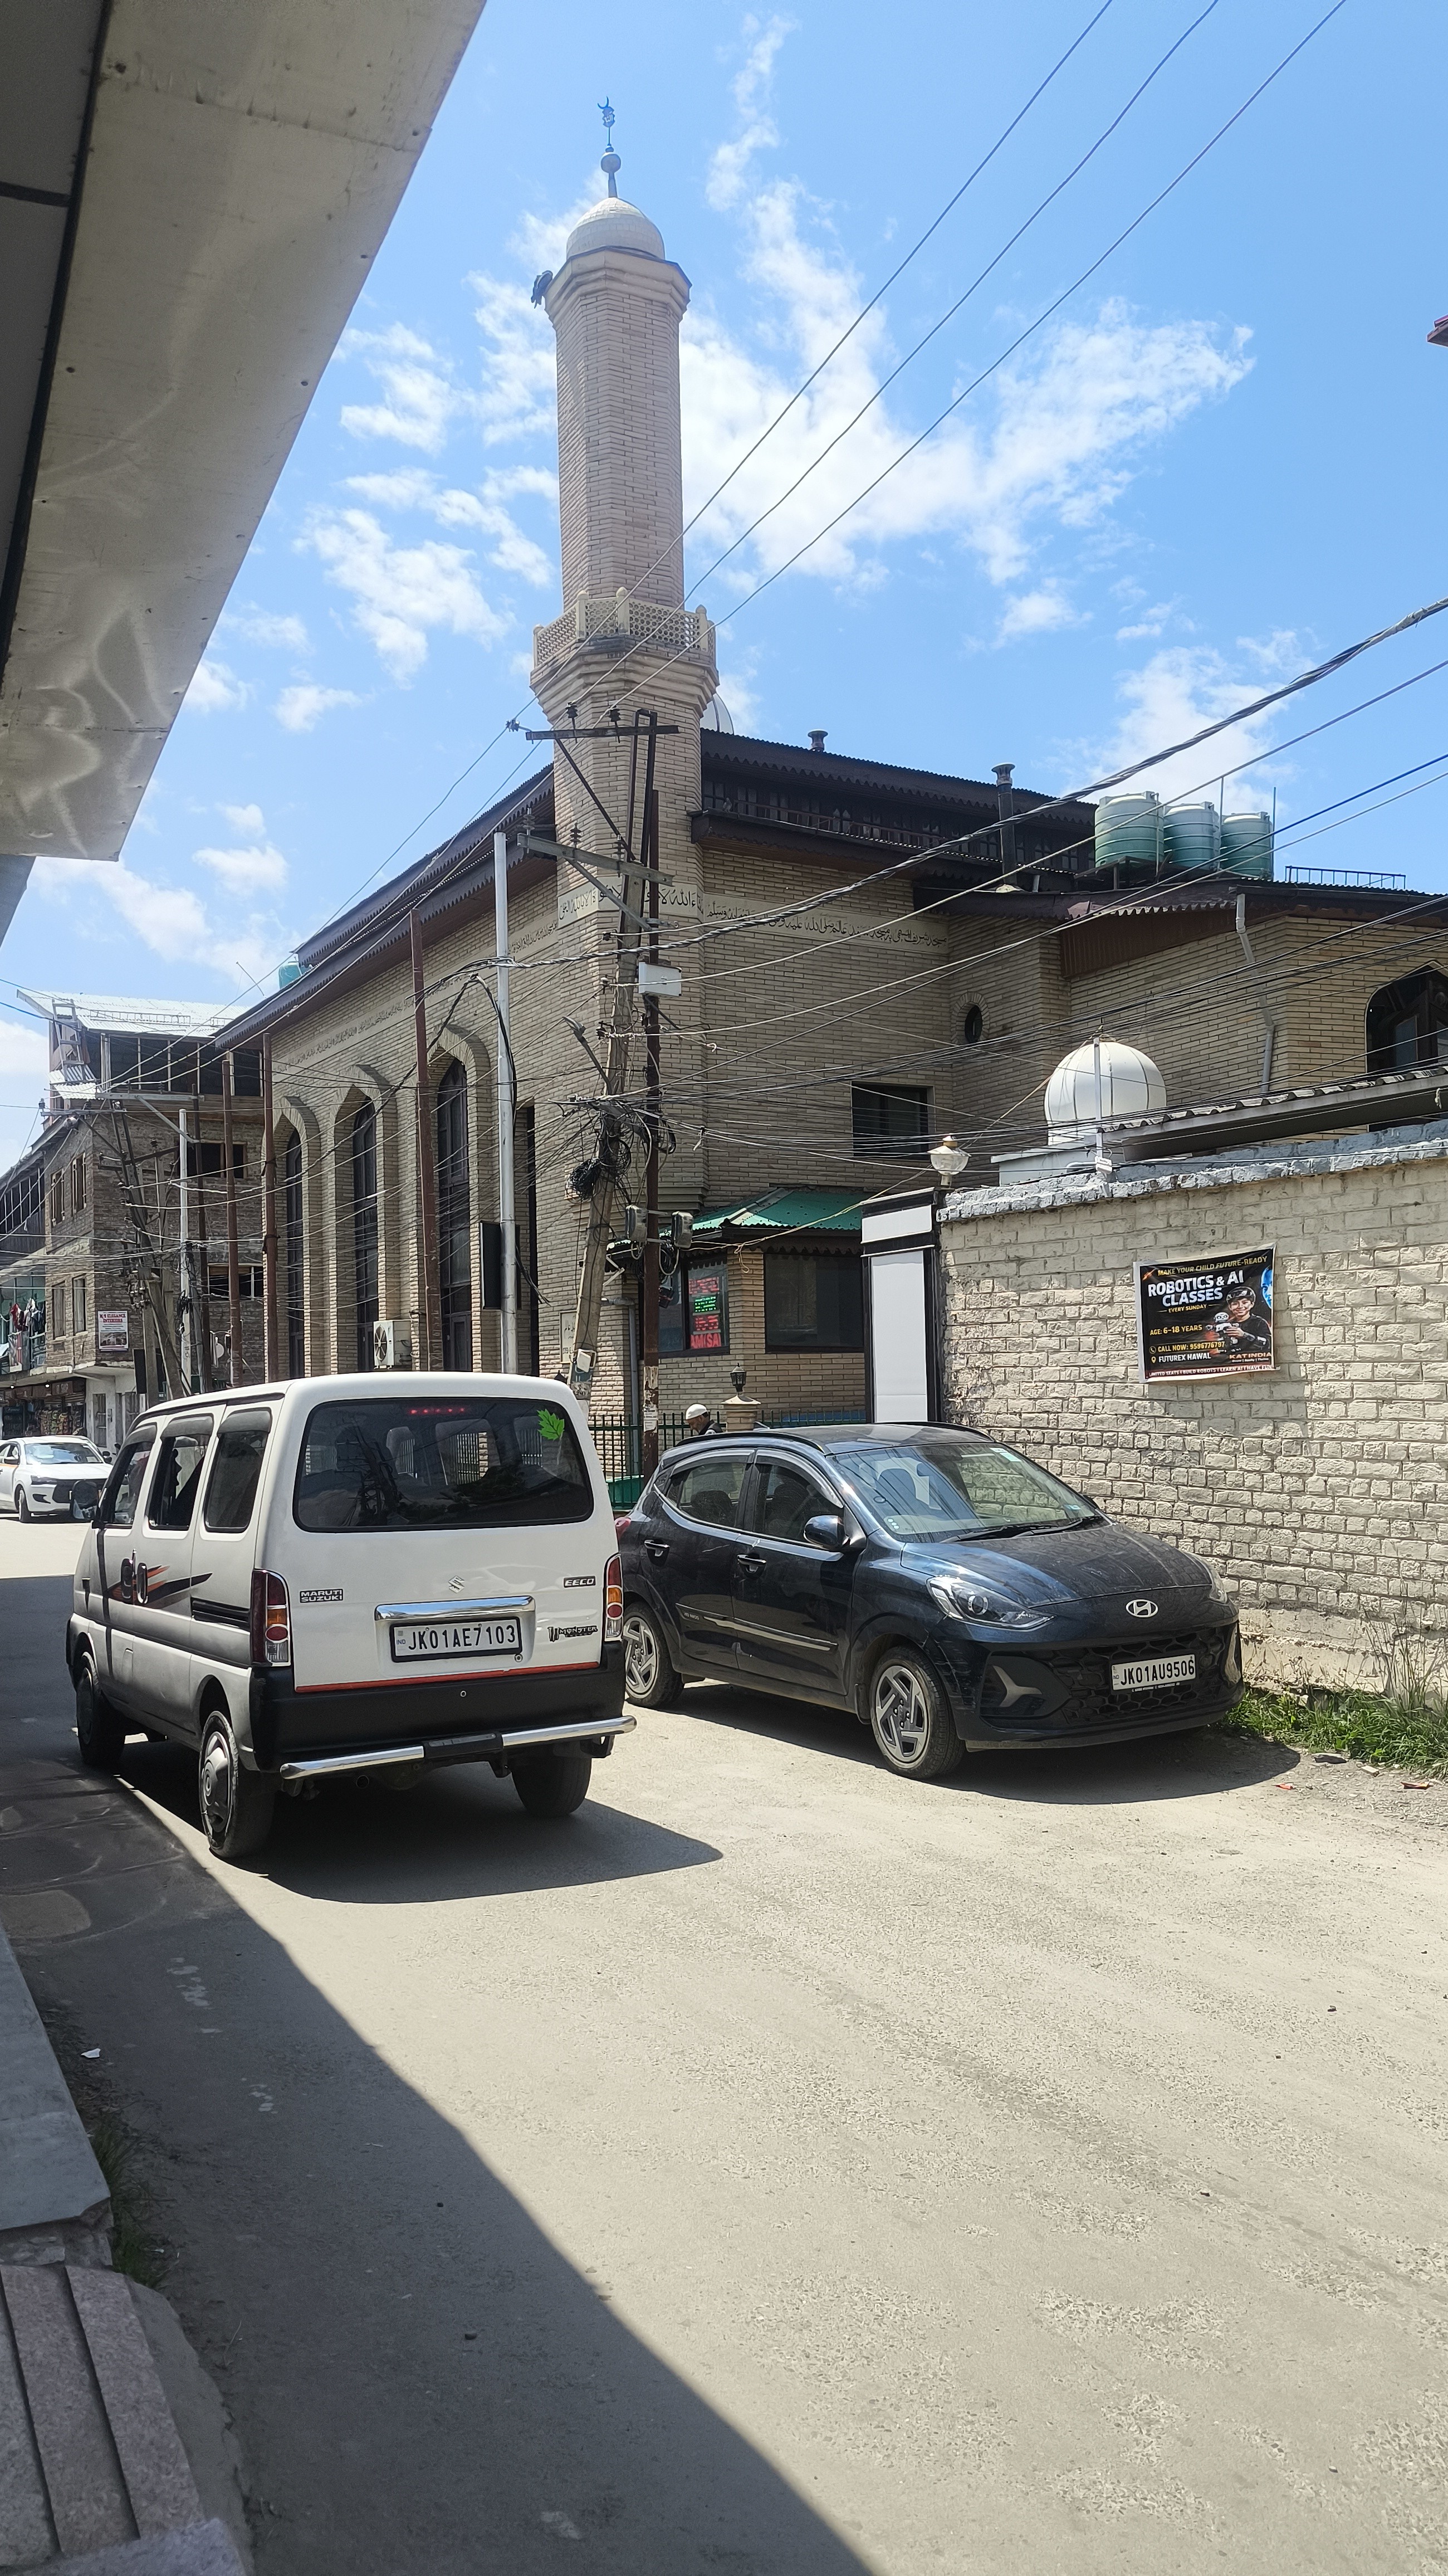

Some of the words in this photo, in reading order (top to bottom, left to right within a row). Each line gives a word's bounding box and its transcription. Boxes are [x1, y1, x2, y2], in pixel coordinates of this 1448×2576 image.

[1195, 1263, 1215, 1272] CHILD
[1215, 1256, 1268, 1269] FUTURE-READY
[1148, 1275, 1214, 1297] ROBOTICS
[1216, 1276, 1225, 1286] &
[1226, 1270, 1244, 1285] AI
[1162, 1287, 1223, 1307] CLASSES
[1158, 1354, 1186, 1363] FUTUREX
[1187, 1352, 1212, 1360] HAWAL
[564, 1578, 595, 1587] EECO
[408, 1624, 516, 1650] JK01AE7103
[1121, 1659, 1195, 1686] JK01AU9506
